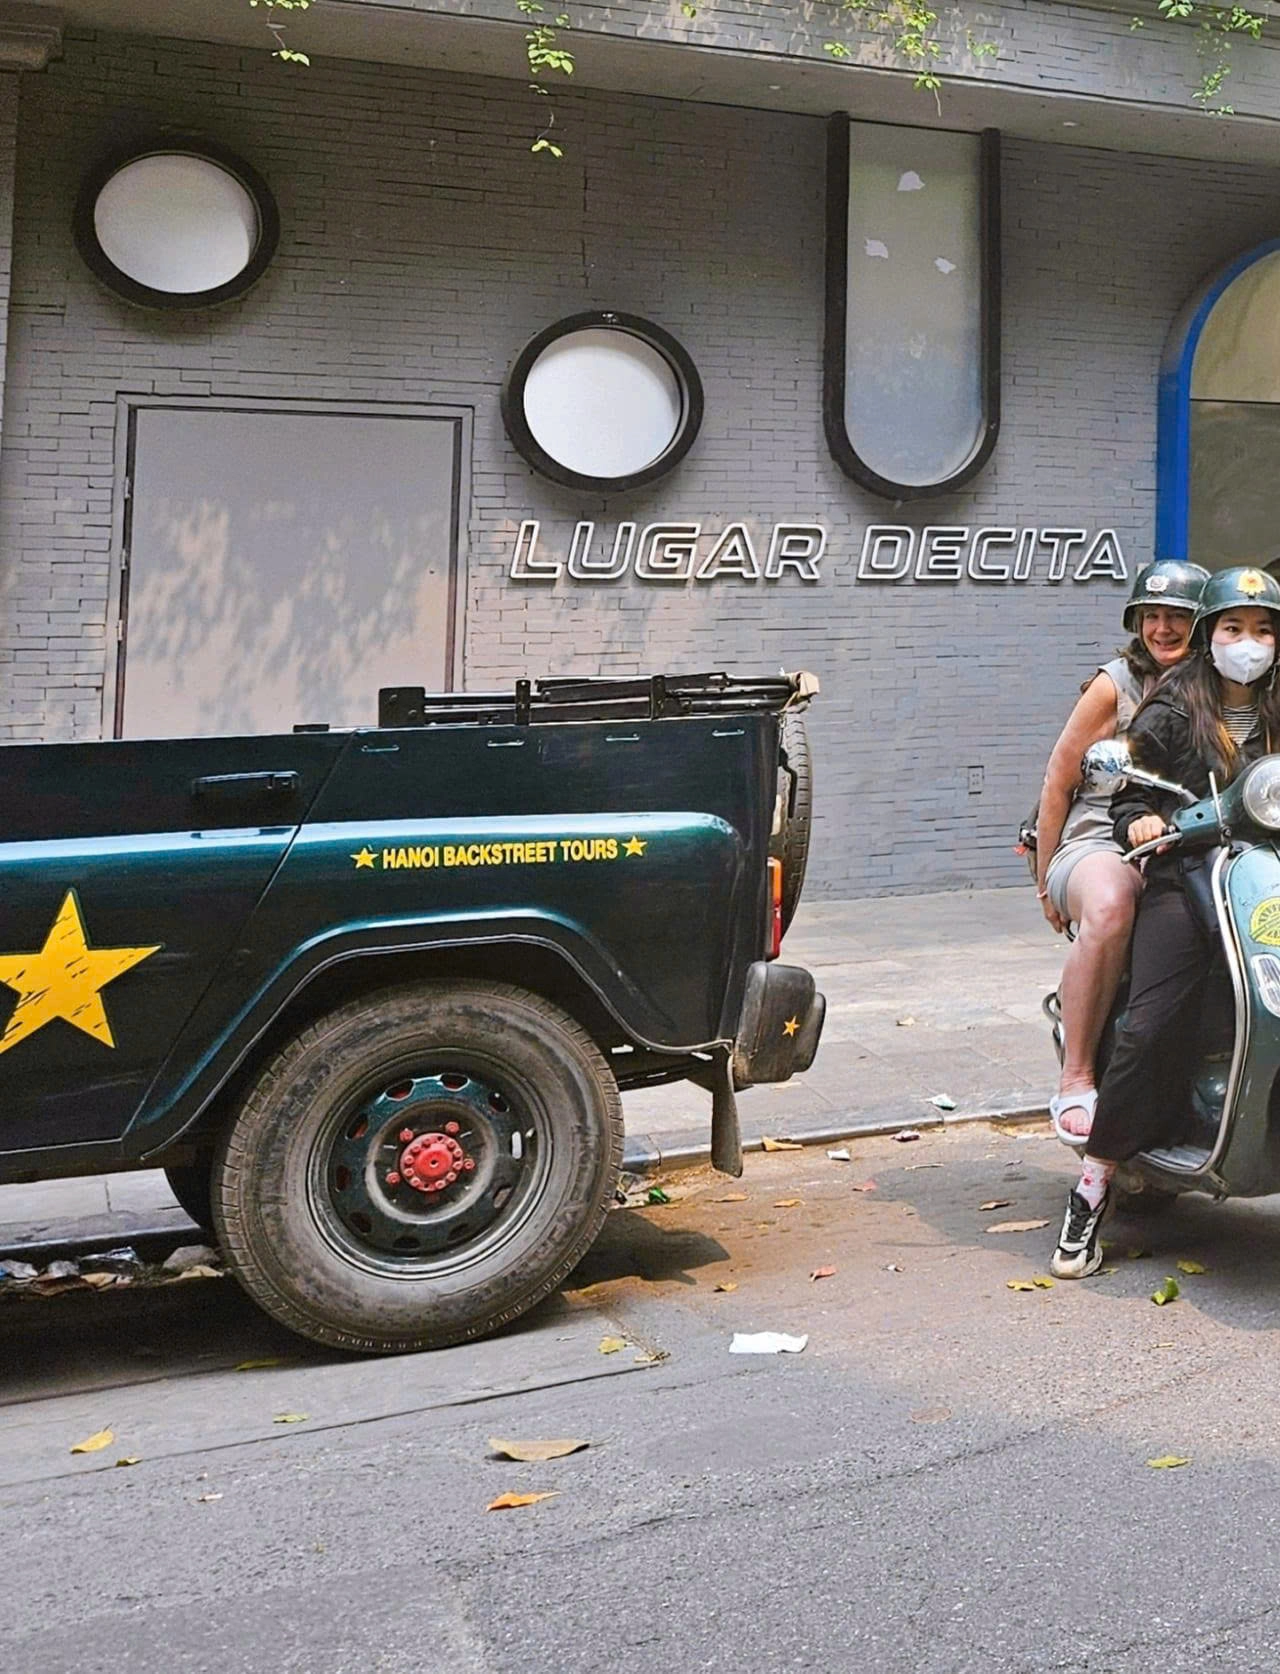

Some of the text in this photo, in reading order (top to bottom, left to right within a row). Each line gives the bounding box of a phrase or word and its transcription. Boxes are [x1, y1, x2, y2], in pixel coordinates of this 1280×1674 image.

[510, 520, 1129, 581] LUGAR DECITA
[382, 839, 618, 869] HANOI BACKSTREET TOURS
